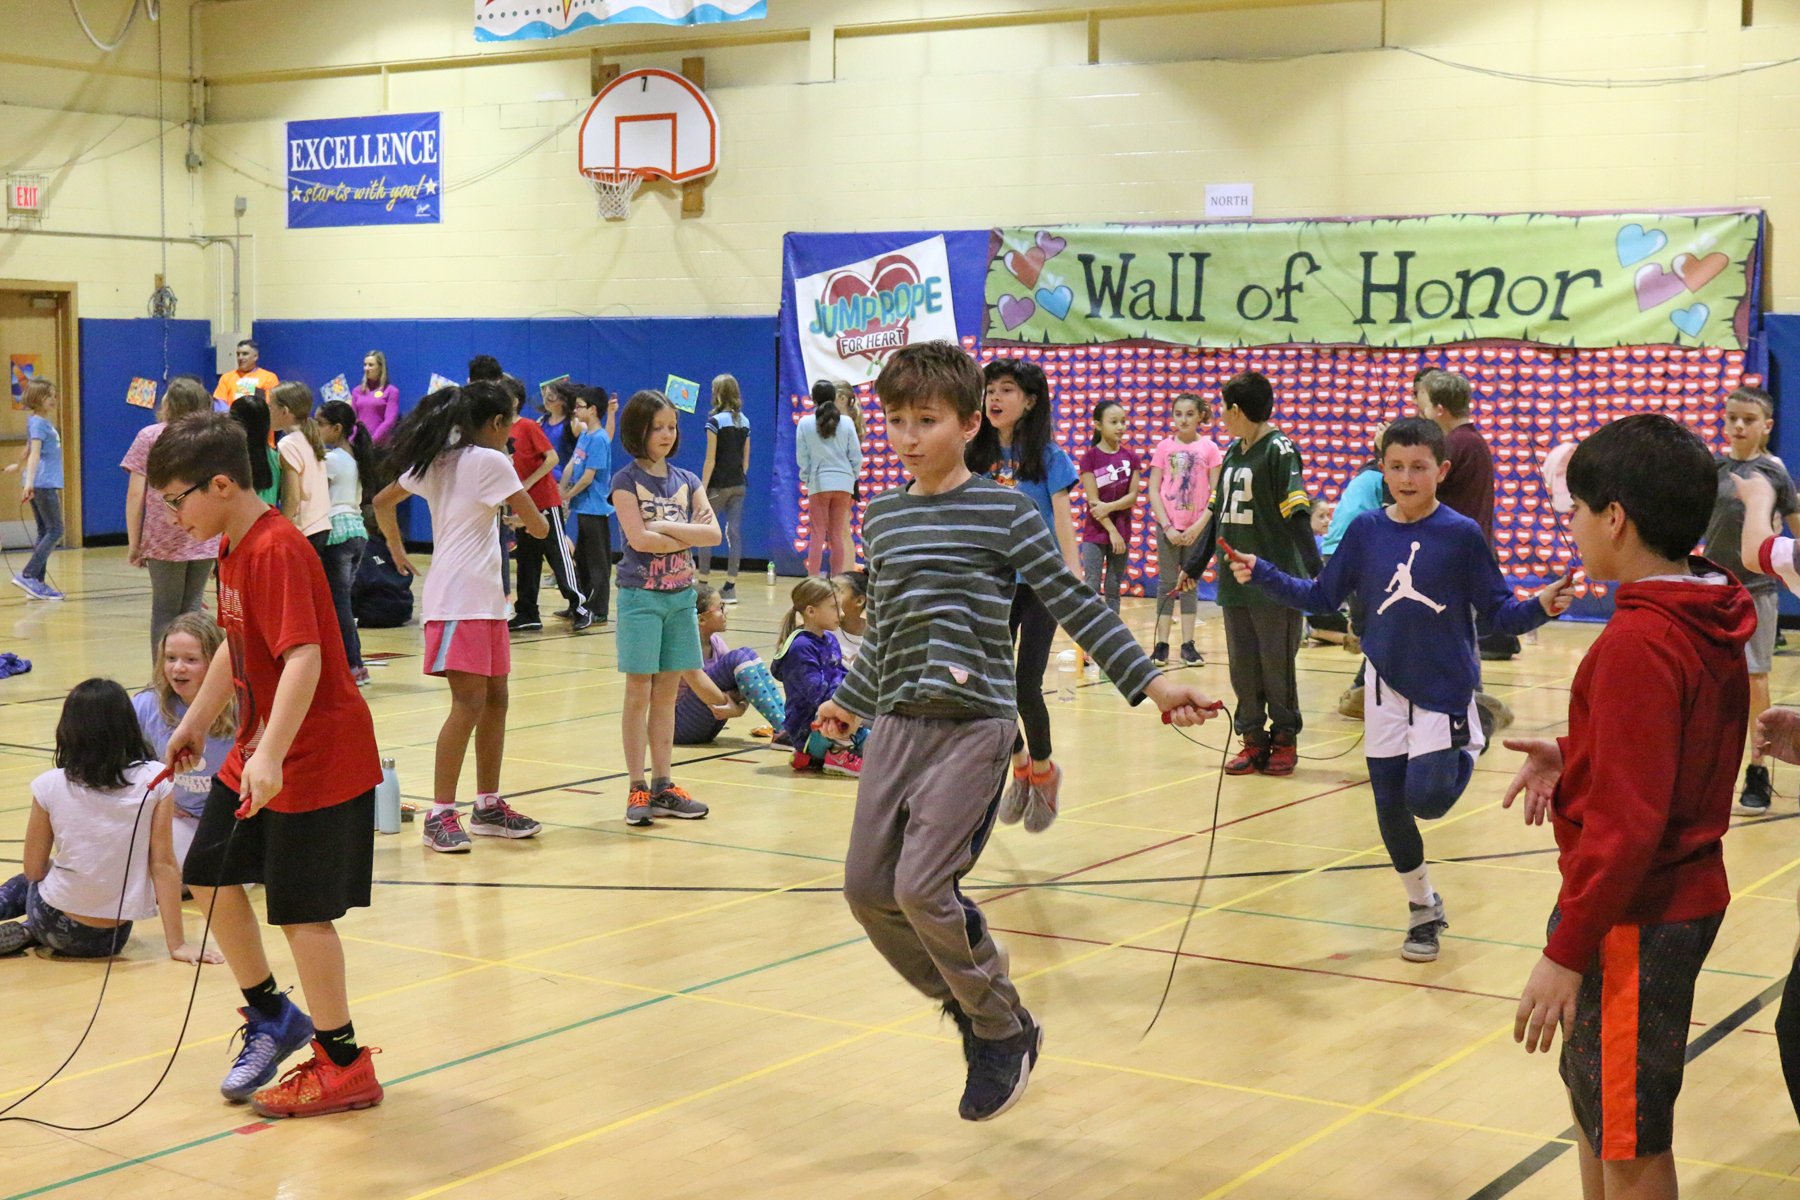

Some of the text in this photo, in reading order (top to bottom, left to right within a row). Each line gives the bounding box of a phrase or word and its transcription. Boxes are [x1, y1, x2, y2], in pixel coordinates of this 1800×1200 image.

[640, 75, 648, 92] 7
[290, 130, 437, 172] EXCELLENCE
[16, 186, 39, 208] EXIT
[303, 182, 351, 203] starts
[353, 176, 387, 200] with
[386, 174, 427, 212] you!
[1210, 195, 1248, 206] NORTH
[1077, 251, 1603, 324] Wall of Honor
[809, 276, 943, 338] JUMP ROPE
[841, 329, 905, 354] FOR HEART
[1272, 436, 1295, 455] 12
[1220, 466, 1254, 525] 12
